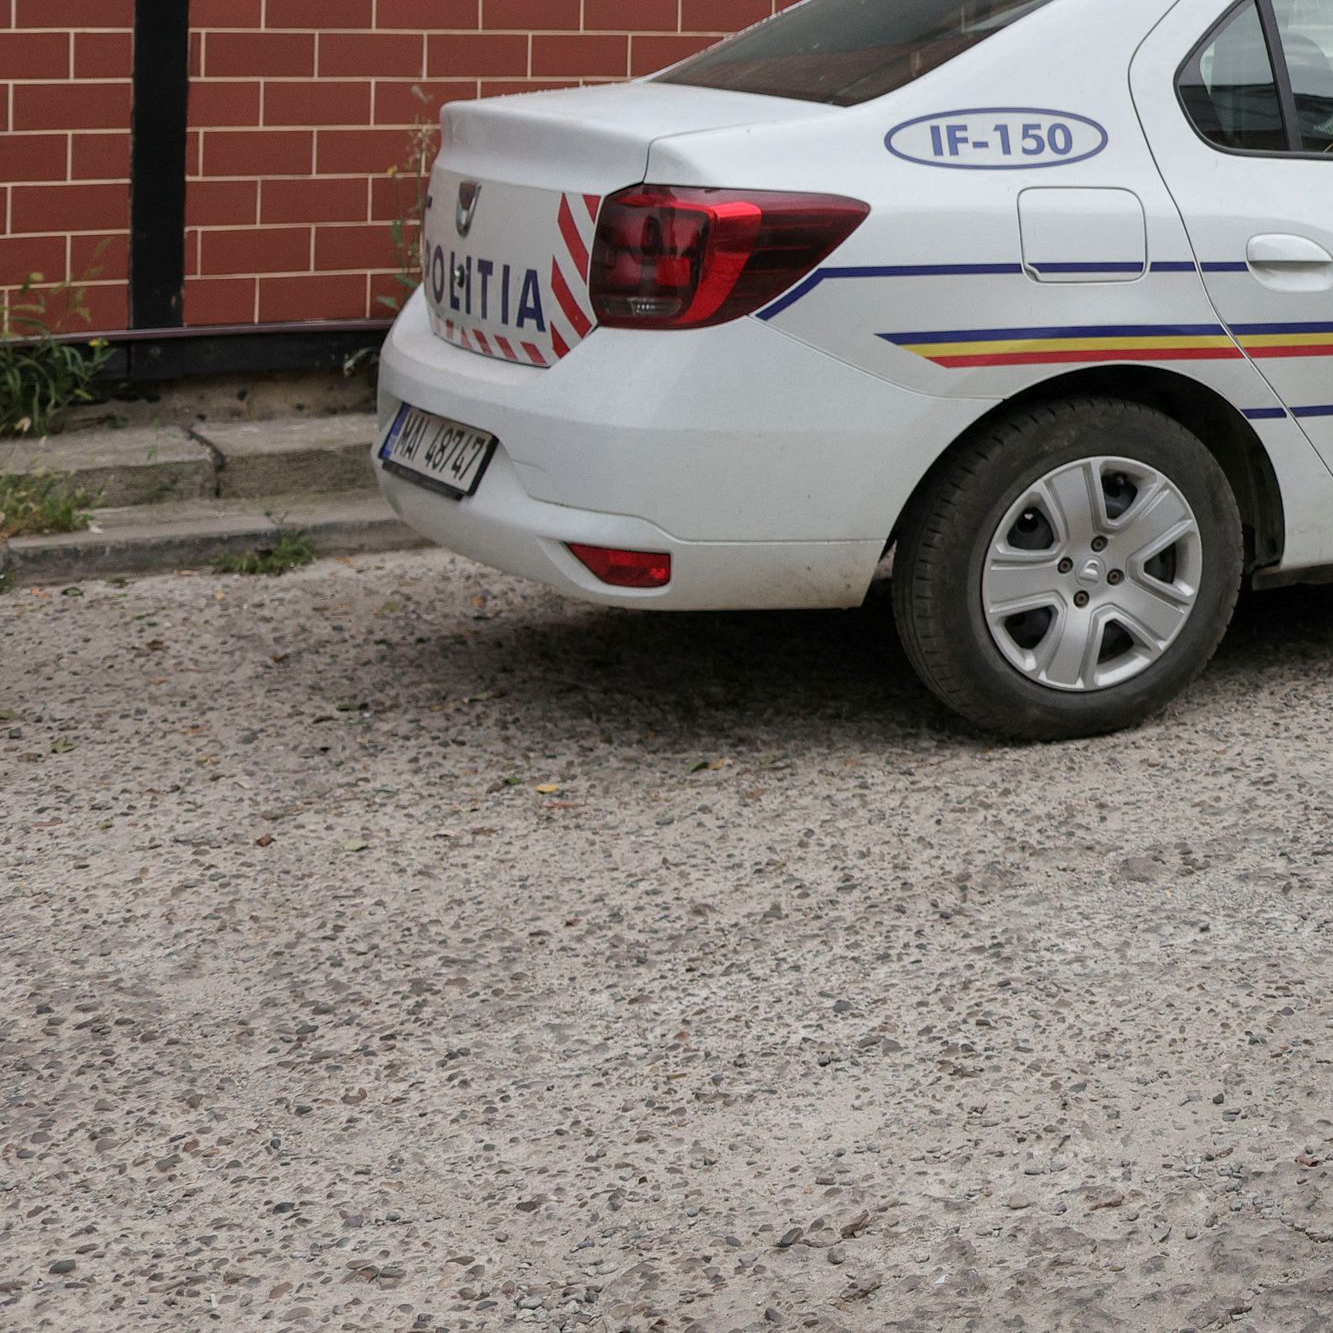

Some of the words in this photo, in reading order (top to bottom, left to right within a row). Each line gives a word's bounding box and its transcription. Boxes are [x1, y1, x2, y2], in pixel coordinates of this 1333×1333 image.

[929, 122, 1074, 157] IF-150
[394, 411, 431, 462] MAI
[424, 423, 486, 481] 48747
